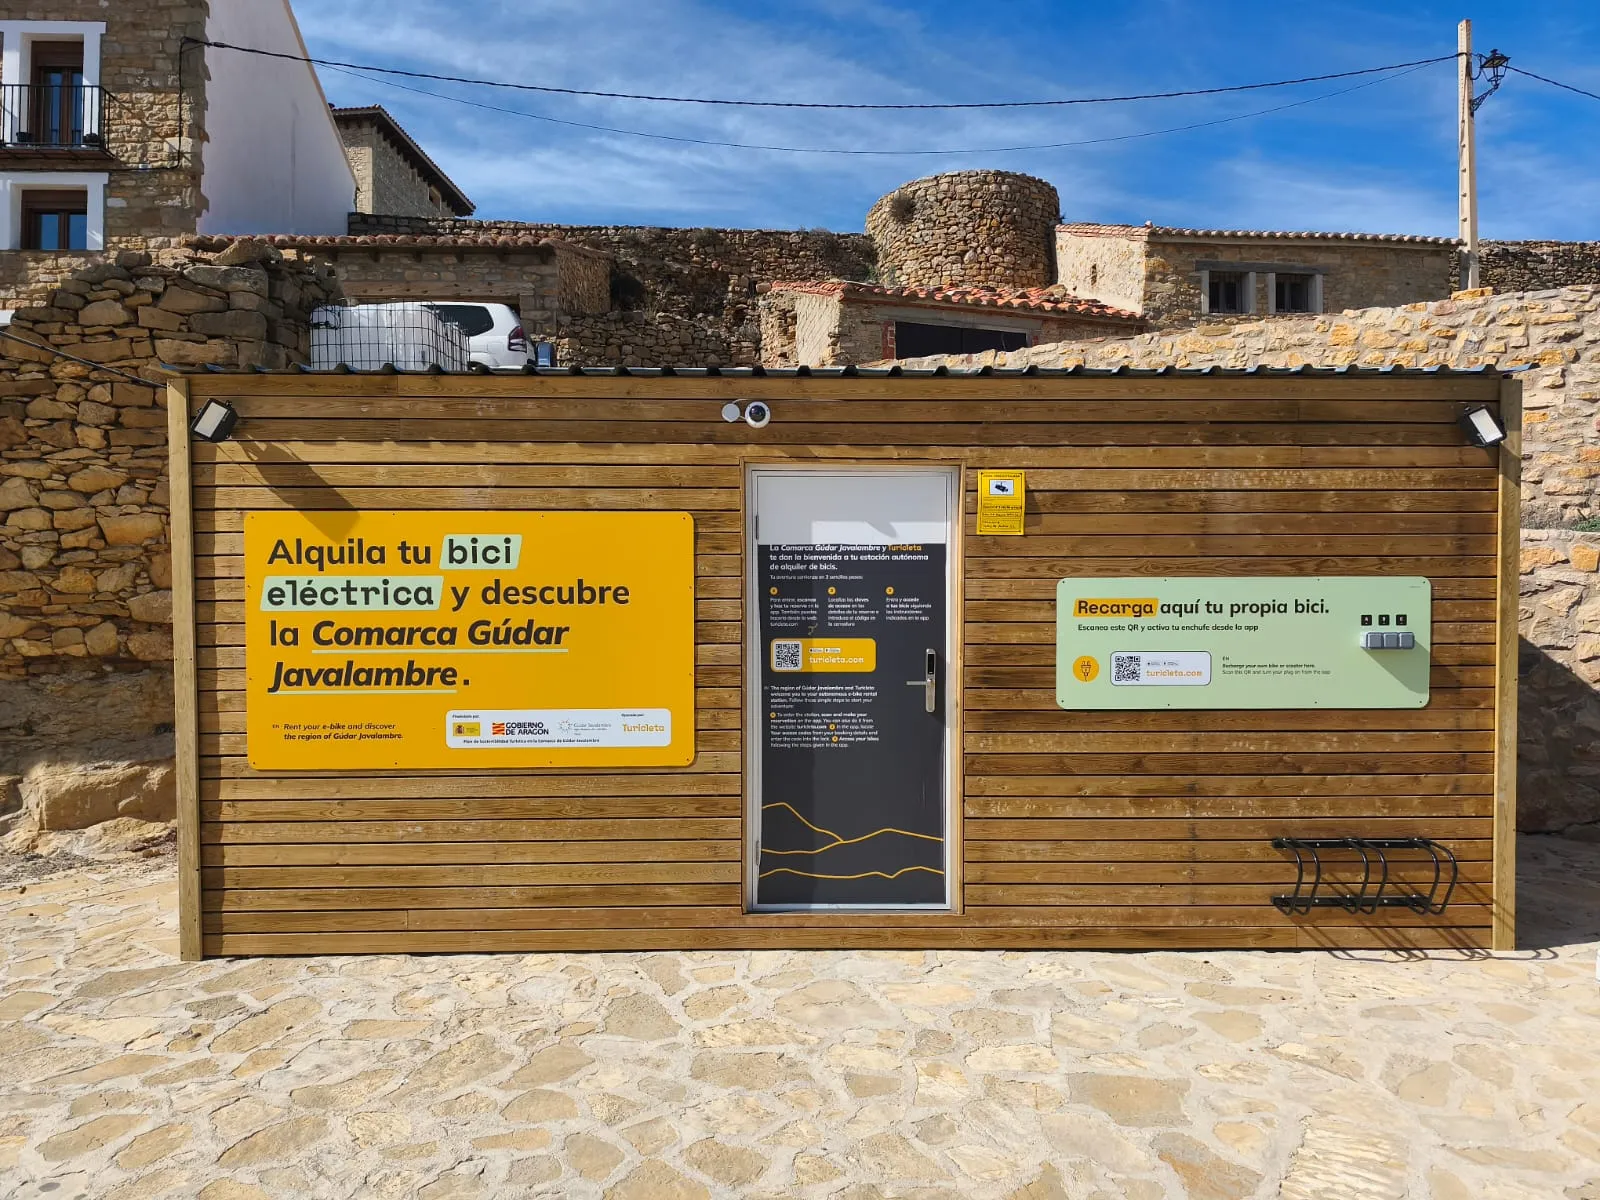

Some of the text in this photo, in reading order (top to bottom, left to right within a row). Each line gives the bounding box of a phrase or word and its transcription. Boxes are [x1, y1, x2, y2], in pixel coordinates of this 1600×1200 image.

[839, 544, 881, 552] Javalambre
[267, 537, 512, 571] Alquila tu bici
[780, 562, 807, 571] alquiler
[267, 578, 630, 612] eléctrica y descubre
[1078, 599, 1329, 617] Recarga aquí tu propia bici.
[270, 618, 569, 646] la Comarca Gúdar
[505, 721, 544, 729] GOBIERNO
[623, 722, 665, 732] Turicleta
[297, 733, 322, 741] region
[358, 732, 404, 740] Javalambre.
